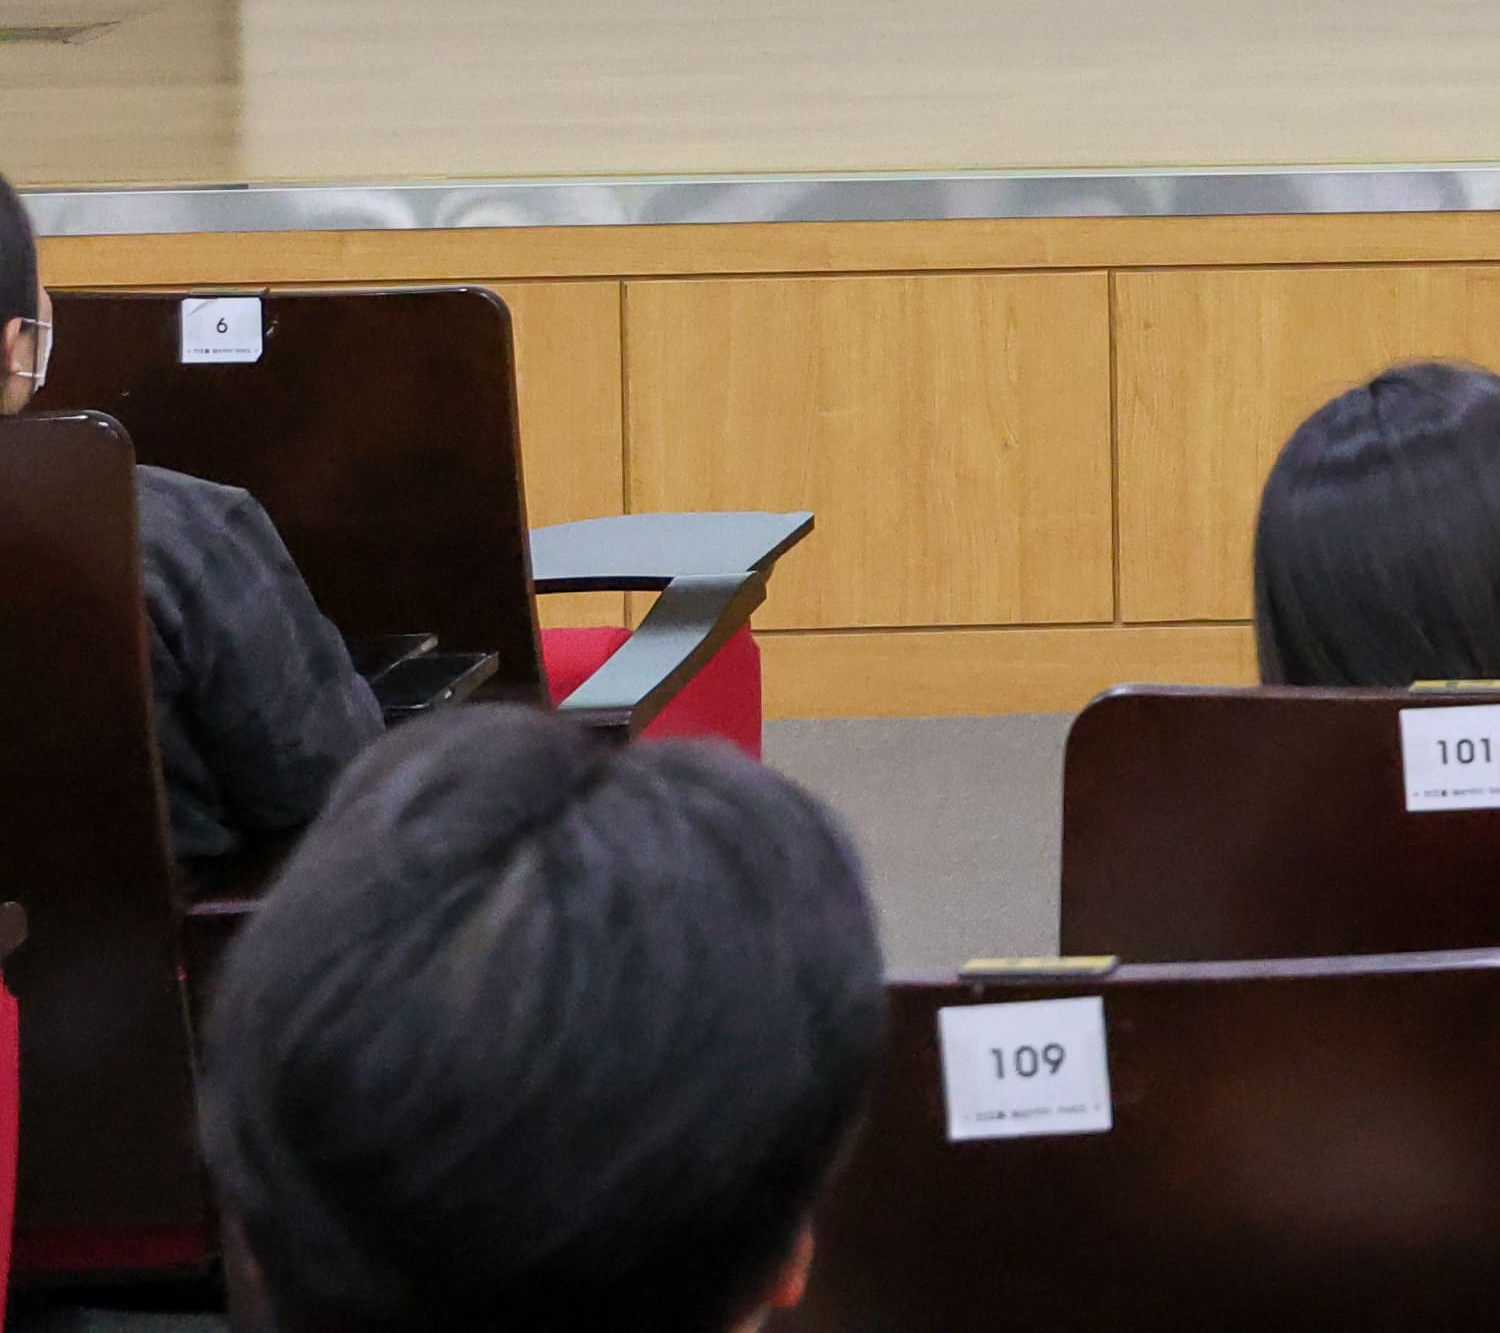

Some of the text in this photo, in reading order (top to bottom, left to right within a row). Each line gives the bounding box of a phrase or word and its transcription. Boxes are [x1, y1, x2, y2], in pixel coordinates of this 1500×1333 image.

[216, 318, 228, 334] 6
[1437, 738, 1491, 765] 101
[991, 1043, 1066, 1079] 109
